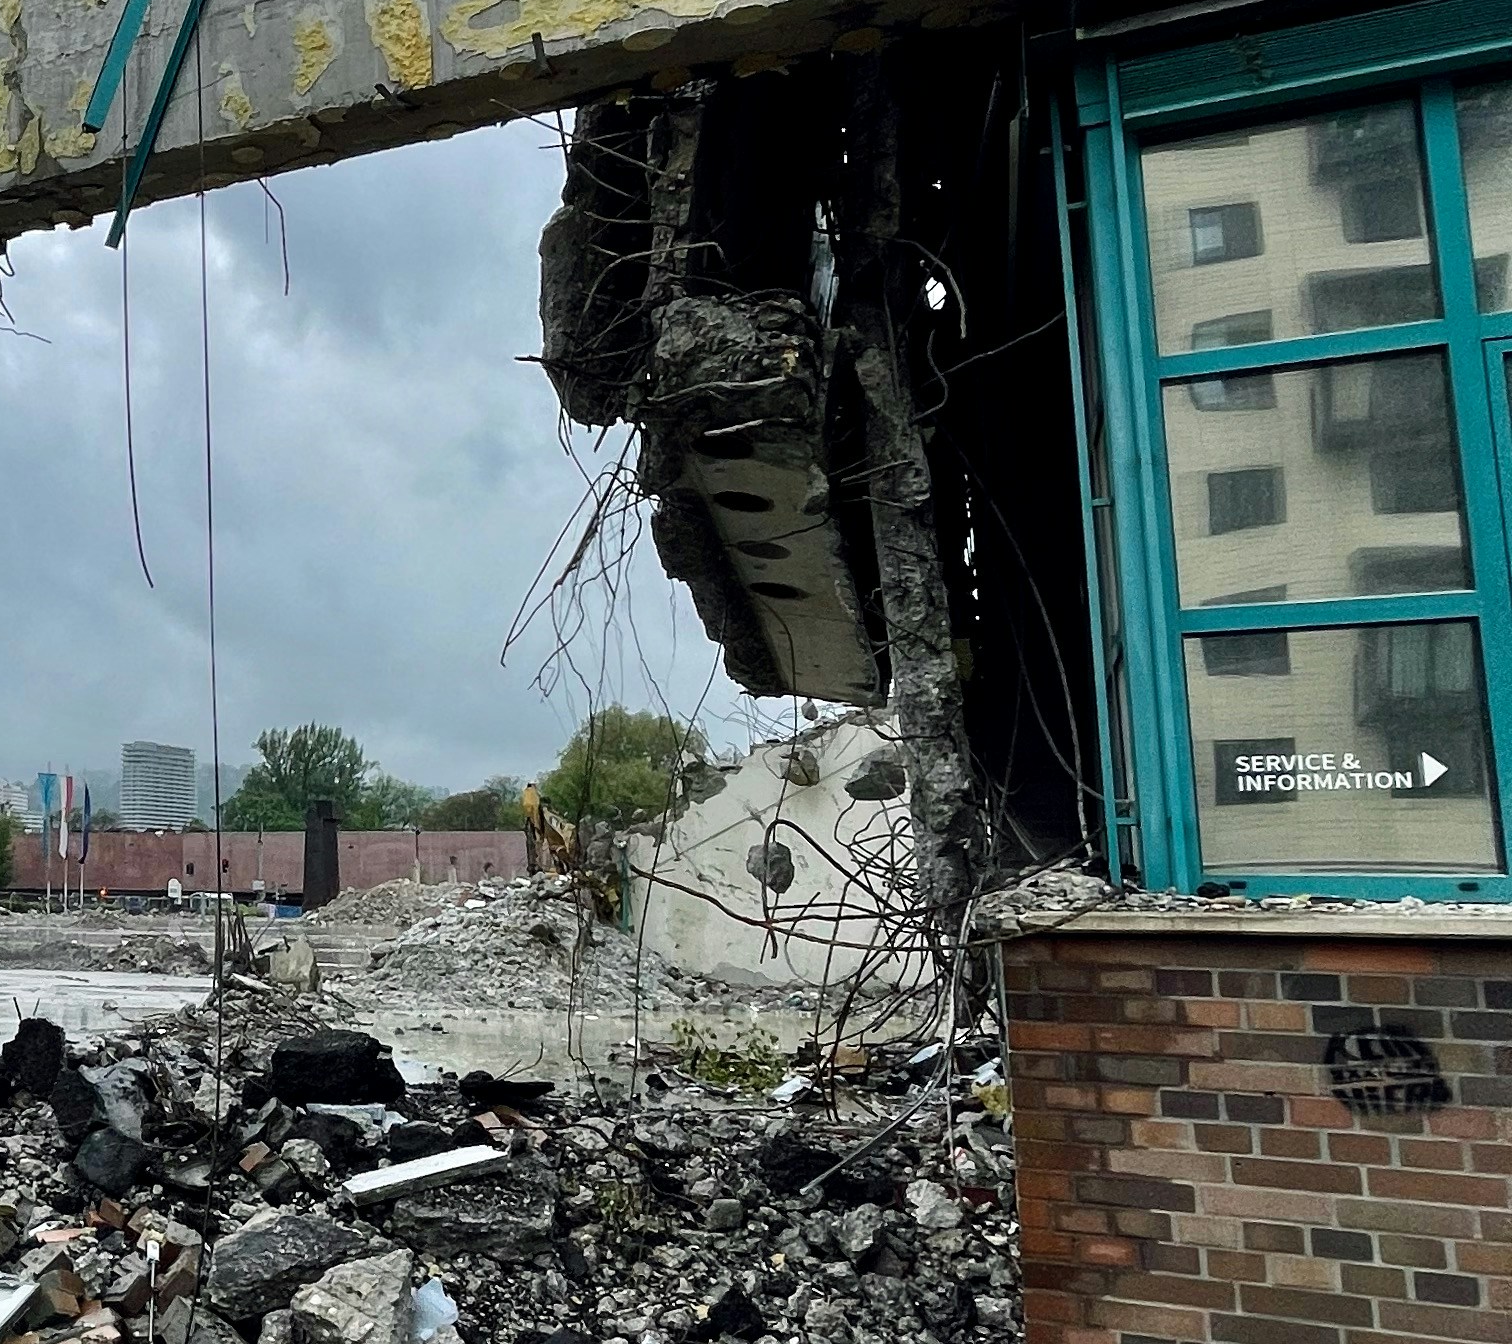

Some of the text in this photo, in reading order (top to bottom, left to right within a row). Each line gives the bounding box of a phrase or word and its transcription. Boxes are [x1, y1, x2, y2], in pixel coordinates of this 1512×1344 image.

[1235, 752, 1361, 773] SERVICE &
[1237, 771, 1413, 792] INFORMATION
